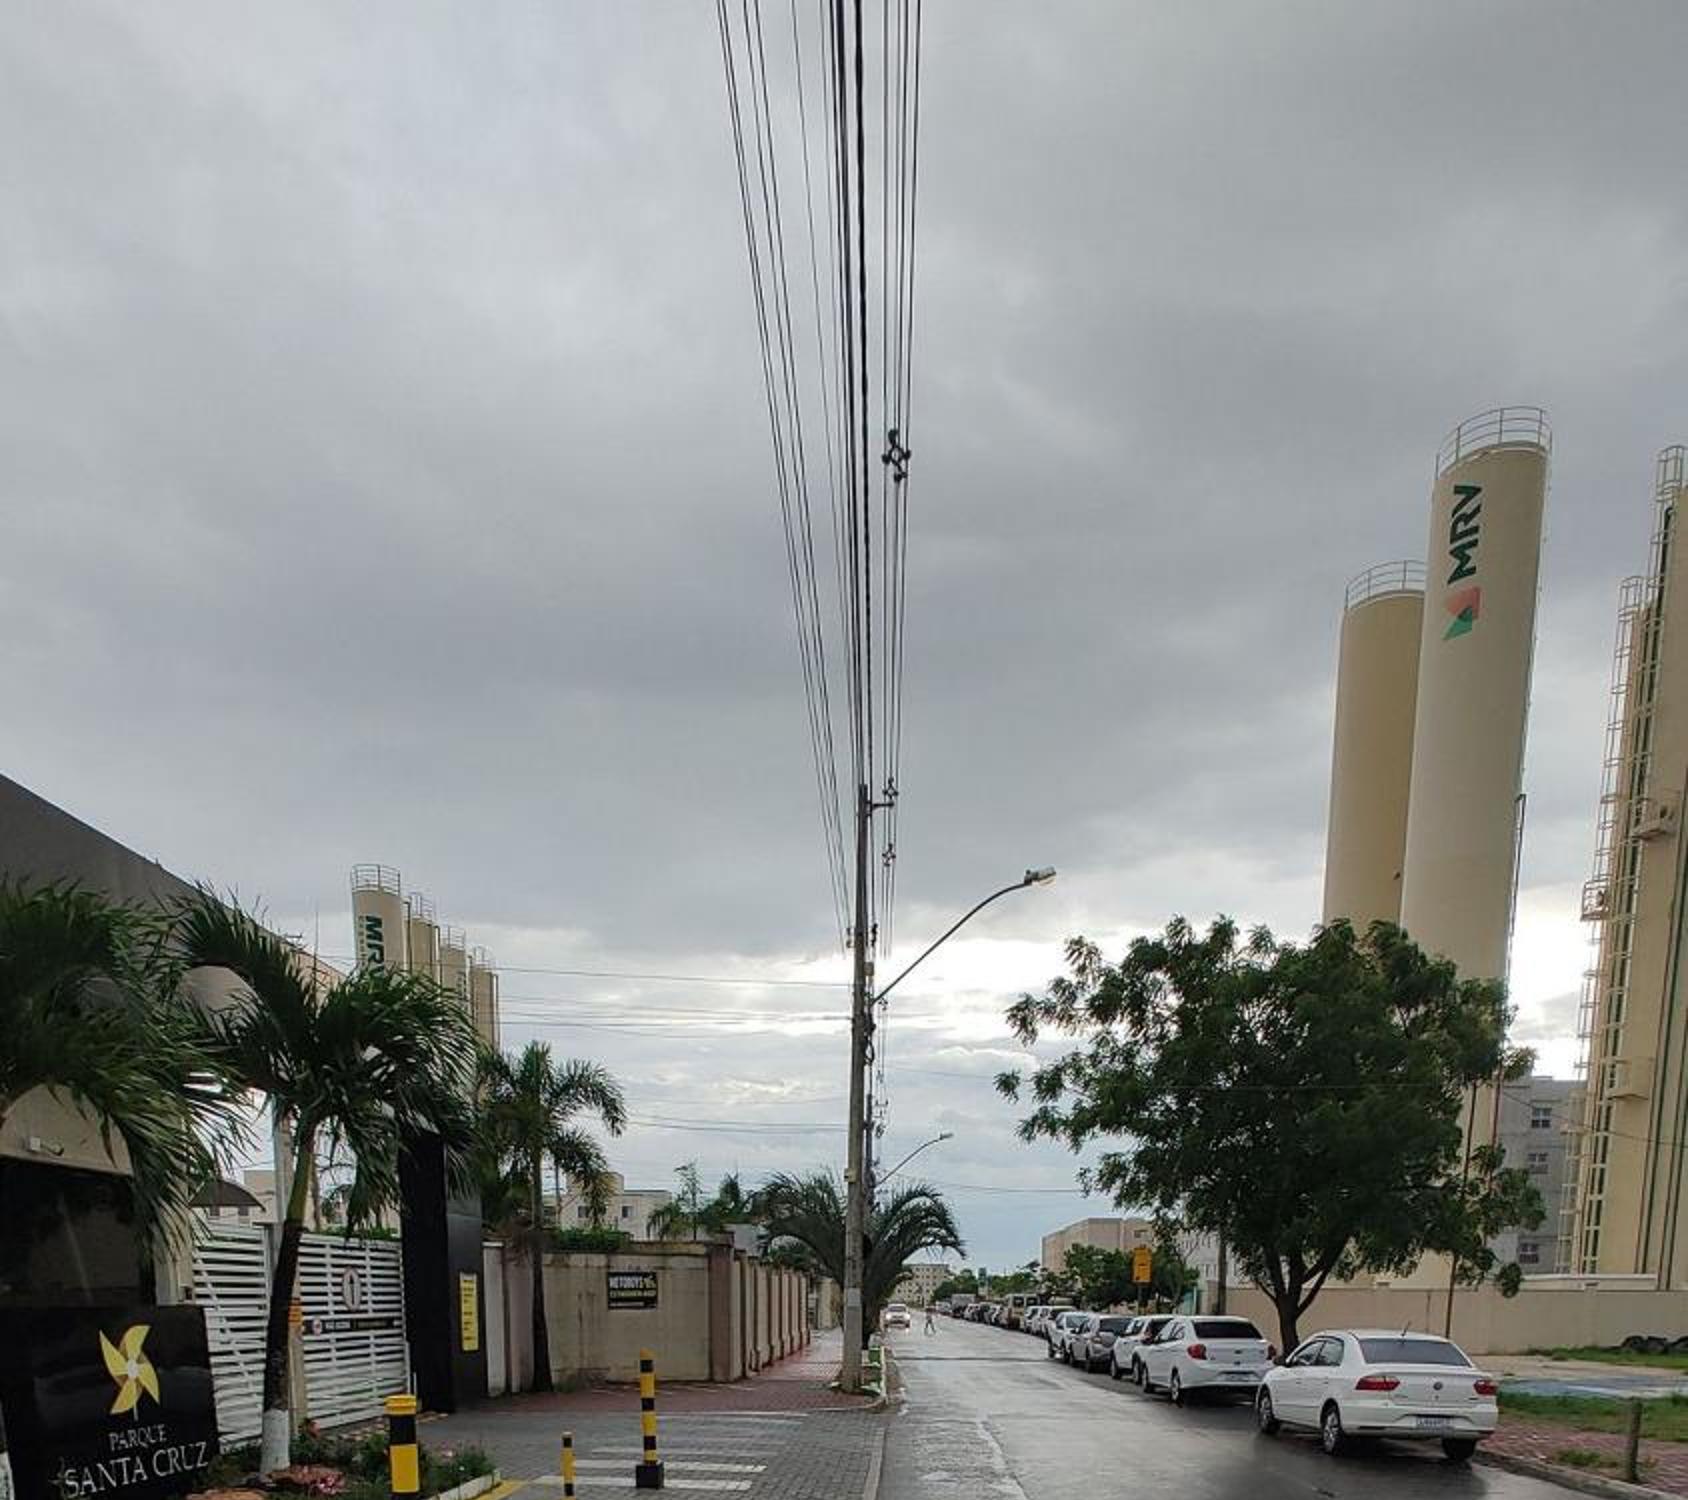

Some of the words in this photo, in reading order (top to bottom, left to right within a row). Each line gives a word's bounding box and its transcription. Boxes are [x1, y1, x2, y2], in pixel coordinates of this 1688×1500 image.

[1447, 485, 1483, 585] MRV
[108, 1424, 167, 1450] PARQUE
[64, 1456, 149, 1499] SANTA
[152, 1441, 209, 1477] CRUZ
